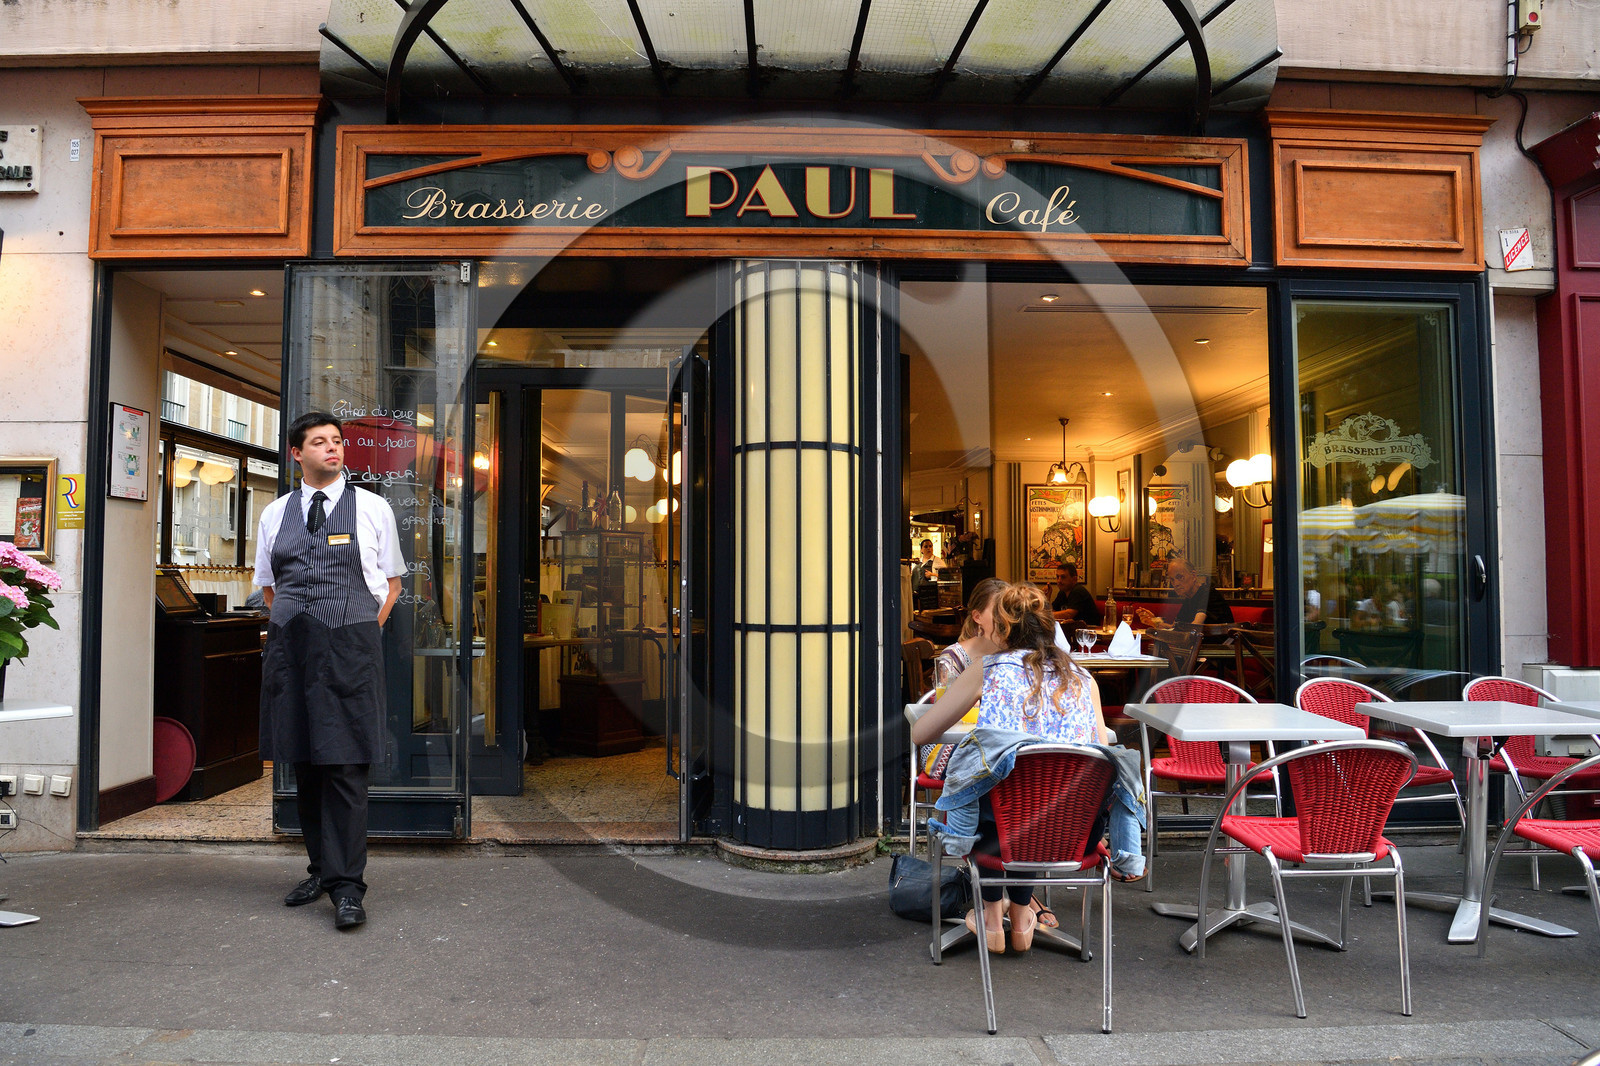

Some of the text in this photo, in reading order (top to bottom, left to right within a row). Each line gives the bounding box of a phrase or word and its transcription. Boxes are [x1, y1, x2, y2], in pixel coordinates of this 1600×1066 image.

[402, 186, 608, 220] Brasserie
[685, 164, 917, 219] PAUL
[985, 185, 1080, 232] Café
[1505, 233, 1529, 265] LICENCE
[371, 405, 388, 417] du
[357, 437, 375, 447] au
[1324, 444, 1417, 456] BRASSERIE PAUL
[361, 465, 382, 482] du
